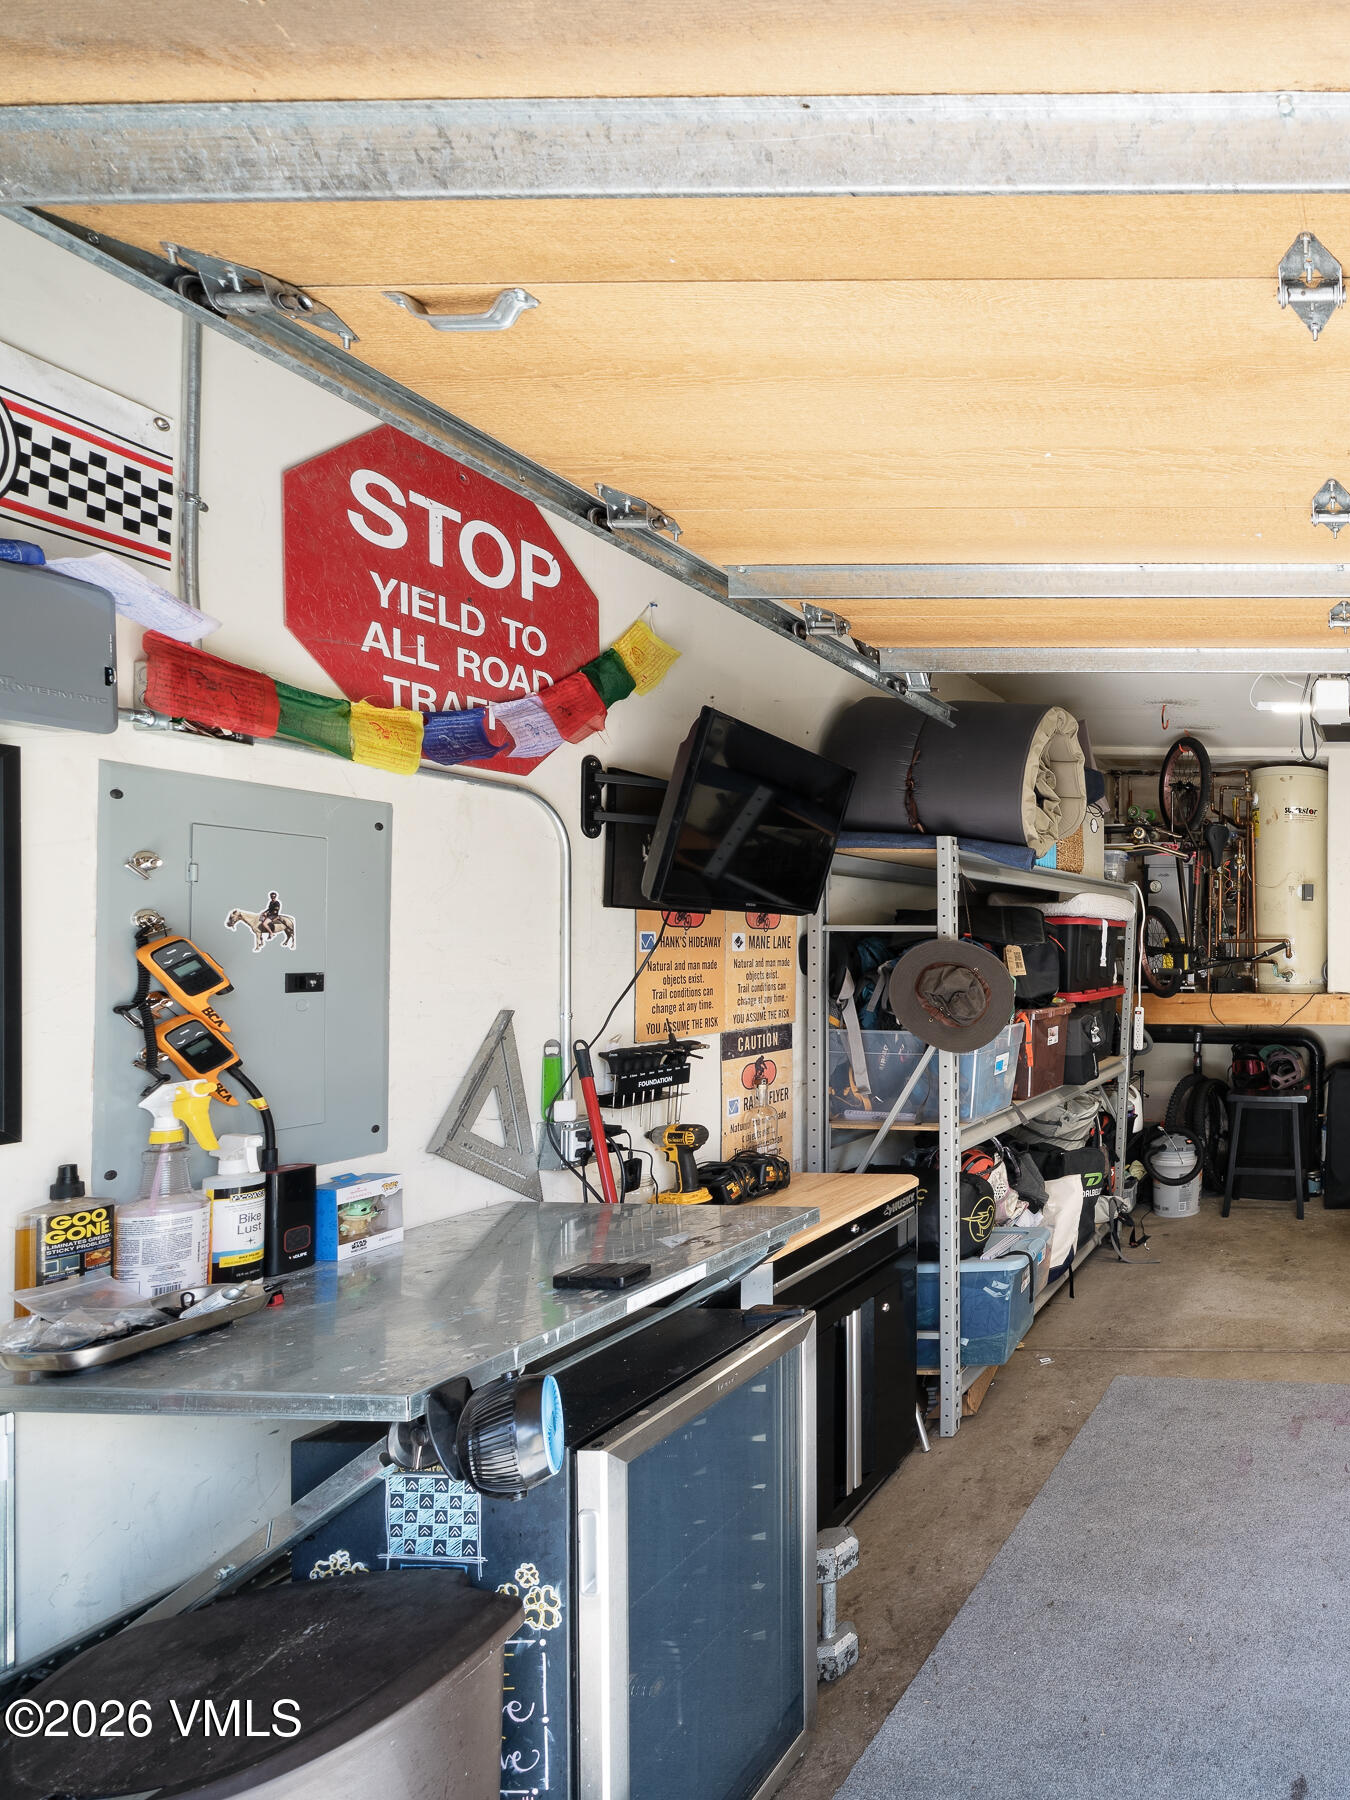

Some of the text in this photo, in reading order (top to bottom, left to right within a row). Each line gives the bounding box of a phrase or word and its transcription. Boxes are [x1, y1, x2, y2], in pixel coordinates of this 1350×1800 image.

[347, 469, 561, 601] STOP
[370, 570, 548, 657] YIELD TO
[361, 621, 554, 694] ALL ROAD
[660, 936, 722, 949] HANK'S HIDEAWAY
[748, 935, 792, 949] MANE LANE
[647, 960, 718, 971] Natural and man made
[733, 957, 790, 969] Natural and man made
[662, 973, 705, 987] objects exist.
[745, 970, 765, 982] objects
[652, 986, 714, 1000] Trail conditions can
[737, 982, 787, 994] Trail conditions can
[651, 999, 714, 1015] change at any time.
[737, 996, 757, 1006] change
[764, 996, 773, 1005] any
[201, 1007, 226, 1028] BCA
[733, 1008, 790, 1024] YOU ASSUME THE RISK
[646, 1022, 661, 1035] YOU
[692, 1018, 703, 1030] THE
[704, 1016, 719, 1028] RISK
[737, 1032, 779, 1052] CAUTION
[638, 1076, 673, 1088] FOUNDATION
[768, 1087, 789, 1105] FLYER
[891, 1192, 916, 1214] HUSKY
[50, 1208, 108, 1230] GOO
[239, 1212, 262, 1224] Bike
[44, 1219, 111, 1245] GONE
[237, 1222, 262, 1235] Lust
[46, 1238, 88, 1251] LIMINATES
[46, 1246, 75, 1256] STICKY
[76, 1238, 111, 1250] PROBLEMS
